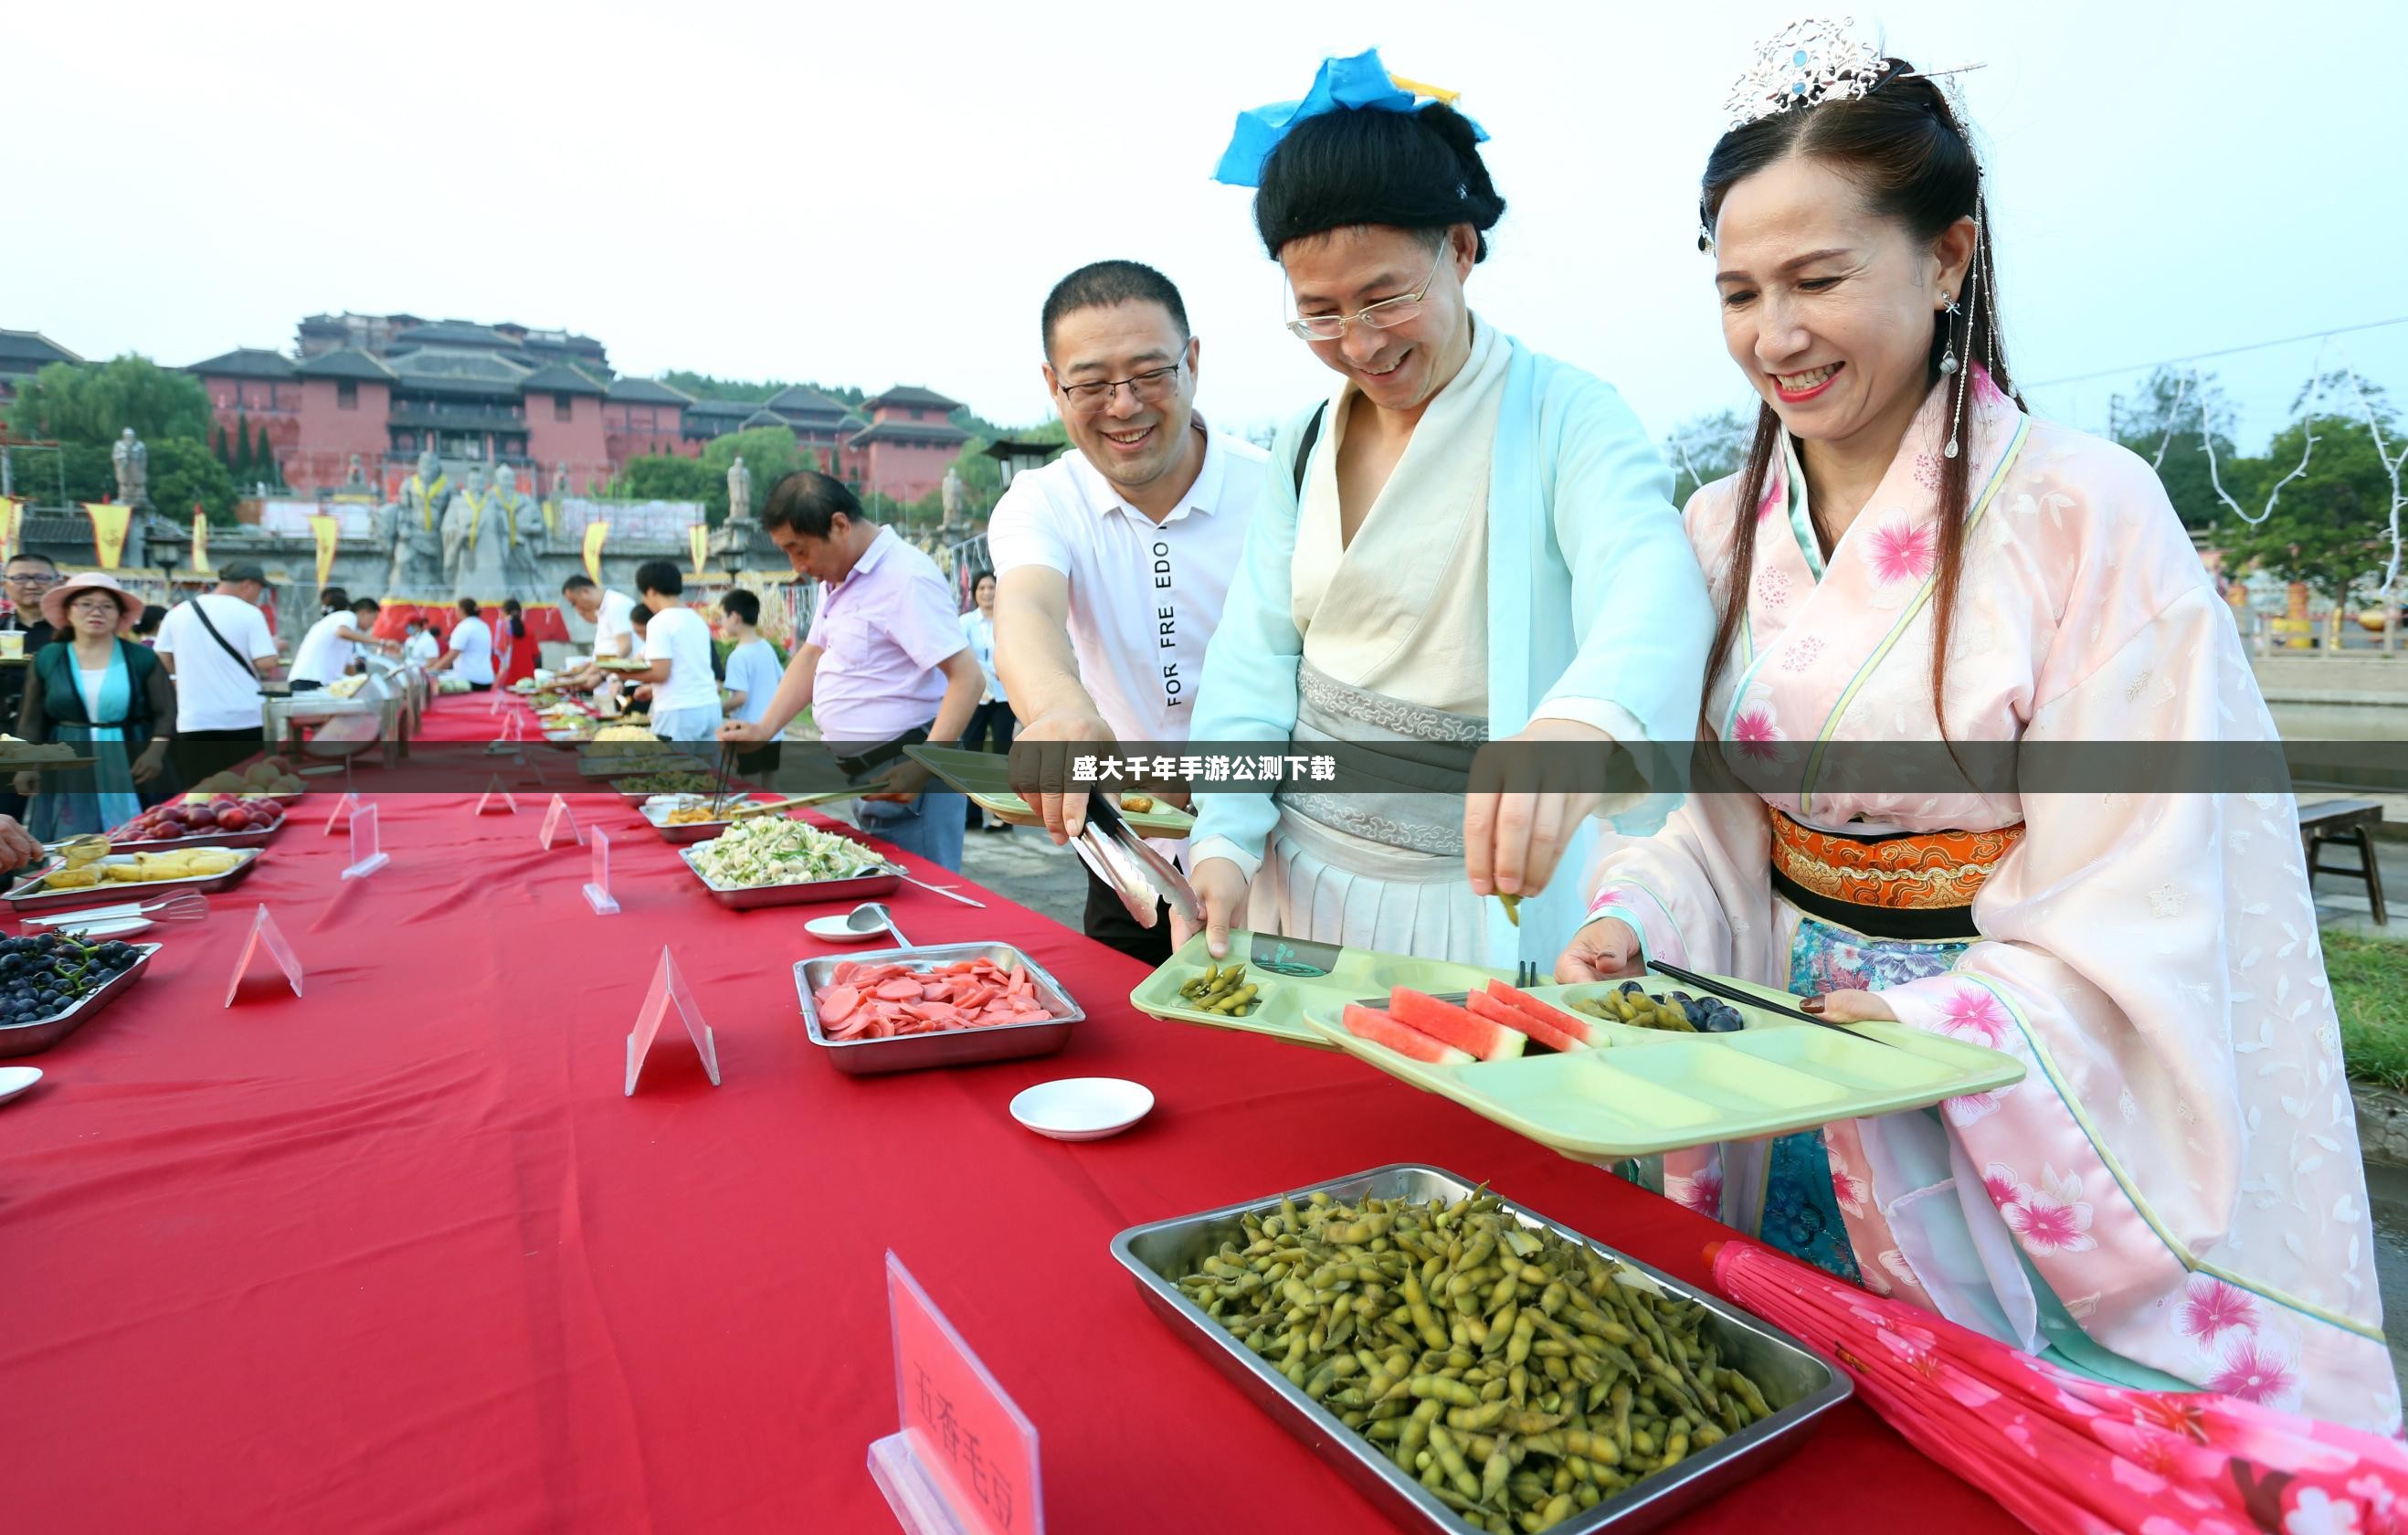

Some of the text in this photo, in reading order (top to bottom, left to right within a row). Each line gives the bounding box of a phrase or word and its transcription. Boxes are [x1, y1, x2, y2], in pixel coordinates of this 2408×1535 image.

[1158, 606, 1176, 648] FRE
[1164, 663, 1181, 707] FOR
[914, 1360, 1014, 1530] 五香毛豆
